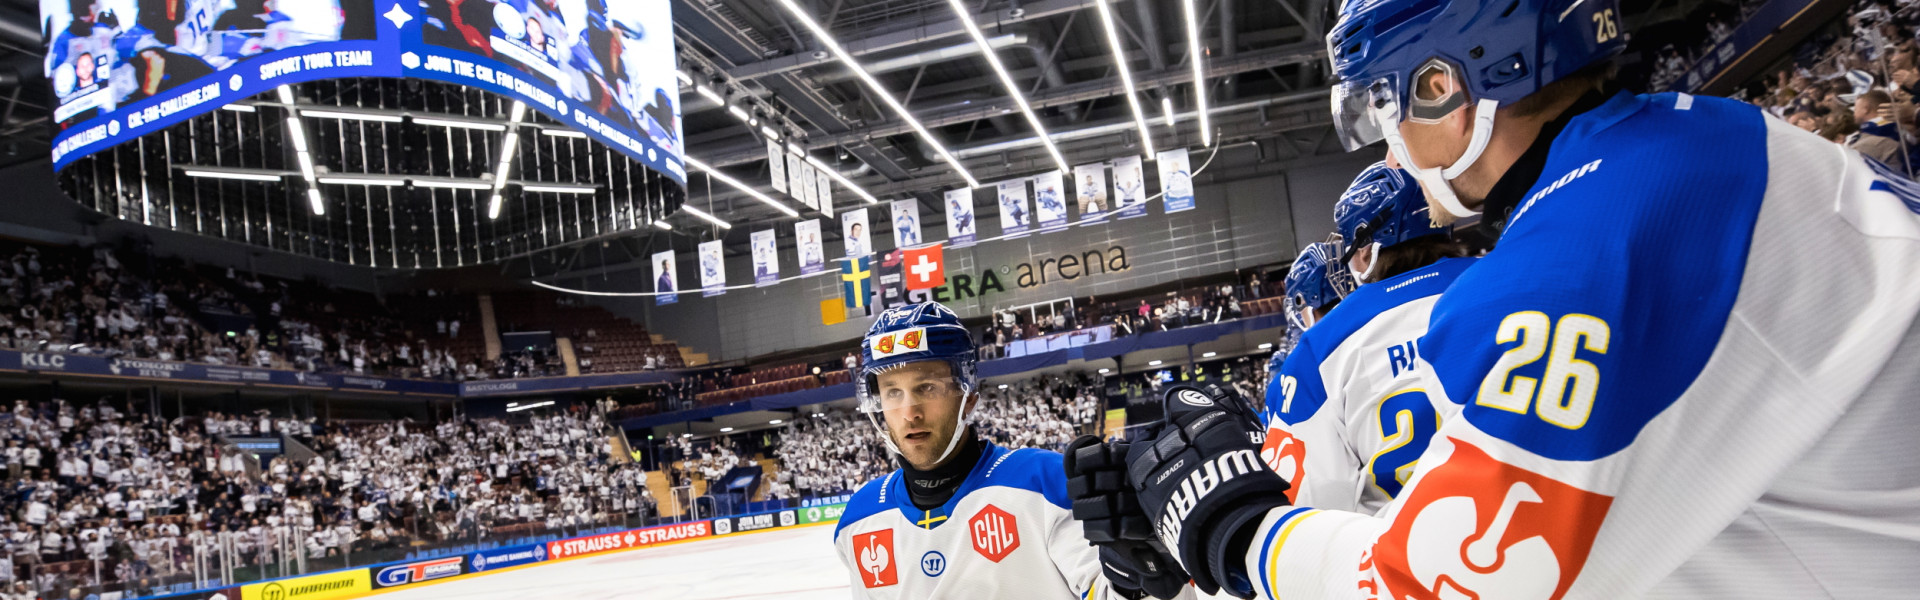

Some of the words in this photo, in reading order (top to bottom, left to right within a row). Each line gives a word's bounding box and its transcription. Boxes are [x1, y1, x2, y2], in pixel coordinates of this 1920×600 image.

[1592, 8, 1617, 43] 26
[260, 56, 301, 80] SUPPORT
[302, 52, 334, 70] YOUR
[334, 50, 373, 67] TEAM!
[424, 55, 452, 73] JOIN
[452, 59, 475, 77] THE
[476, 64, 496, 83] CHL
[496, 70, 514, 90] FAN
[514, 78, 556, 110] CHALLENGE!
[1016, 244, 1130, 288] arena
[21, 352, 65, 368] KLC
[123, 360, 185, 371] TOMOKU
[1475, 310, 1611, 431] 26
[1156, 458, 1185, 485] COVERT
[564, 535, 622, 556] STRAUSS
[639, 523, 706, 544] STRAUSS
[973, 512, 1014, 555] CHL
[377, 556, 463, 587] GT
[486, 555, 508, 564] PRIVATE
[509, 551, 533, 562] BANKING
[289, 579, 355, 597] WARRIOR
